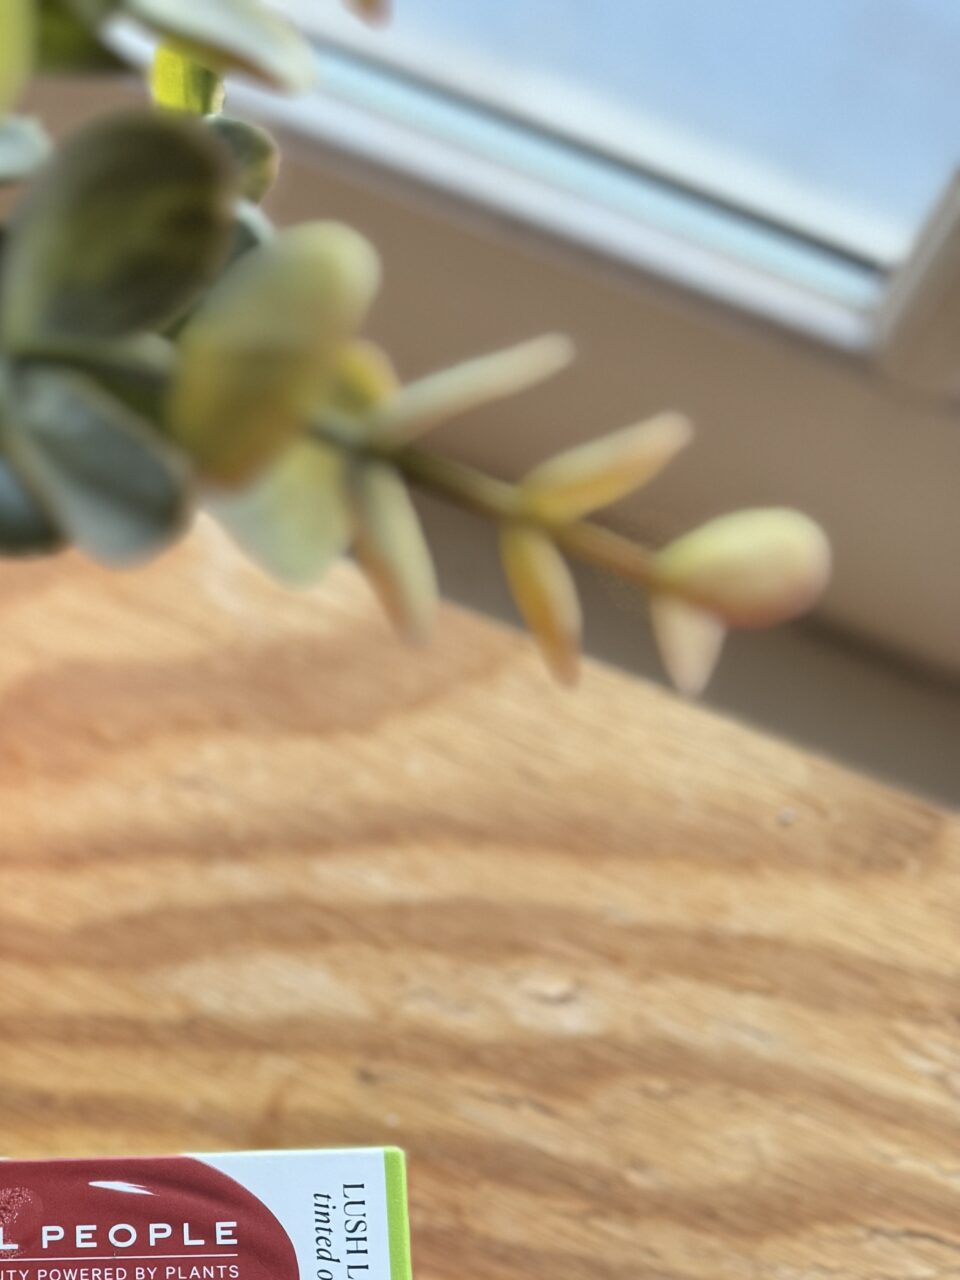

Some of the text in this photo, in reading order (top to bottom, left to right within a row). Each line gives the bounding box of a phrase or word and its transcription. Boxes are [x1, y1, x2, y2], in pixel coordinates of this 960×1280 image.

[42, 1221, 238, 1248] PEOPLE
[313, 1193, 340, 1263] tinted
[343, 1184, 368, 1254] LUSH
[136, 1267, 157, 1280] BY
[166, 1265, 239, 1279] PLANTS
